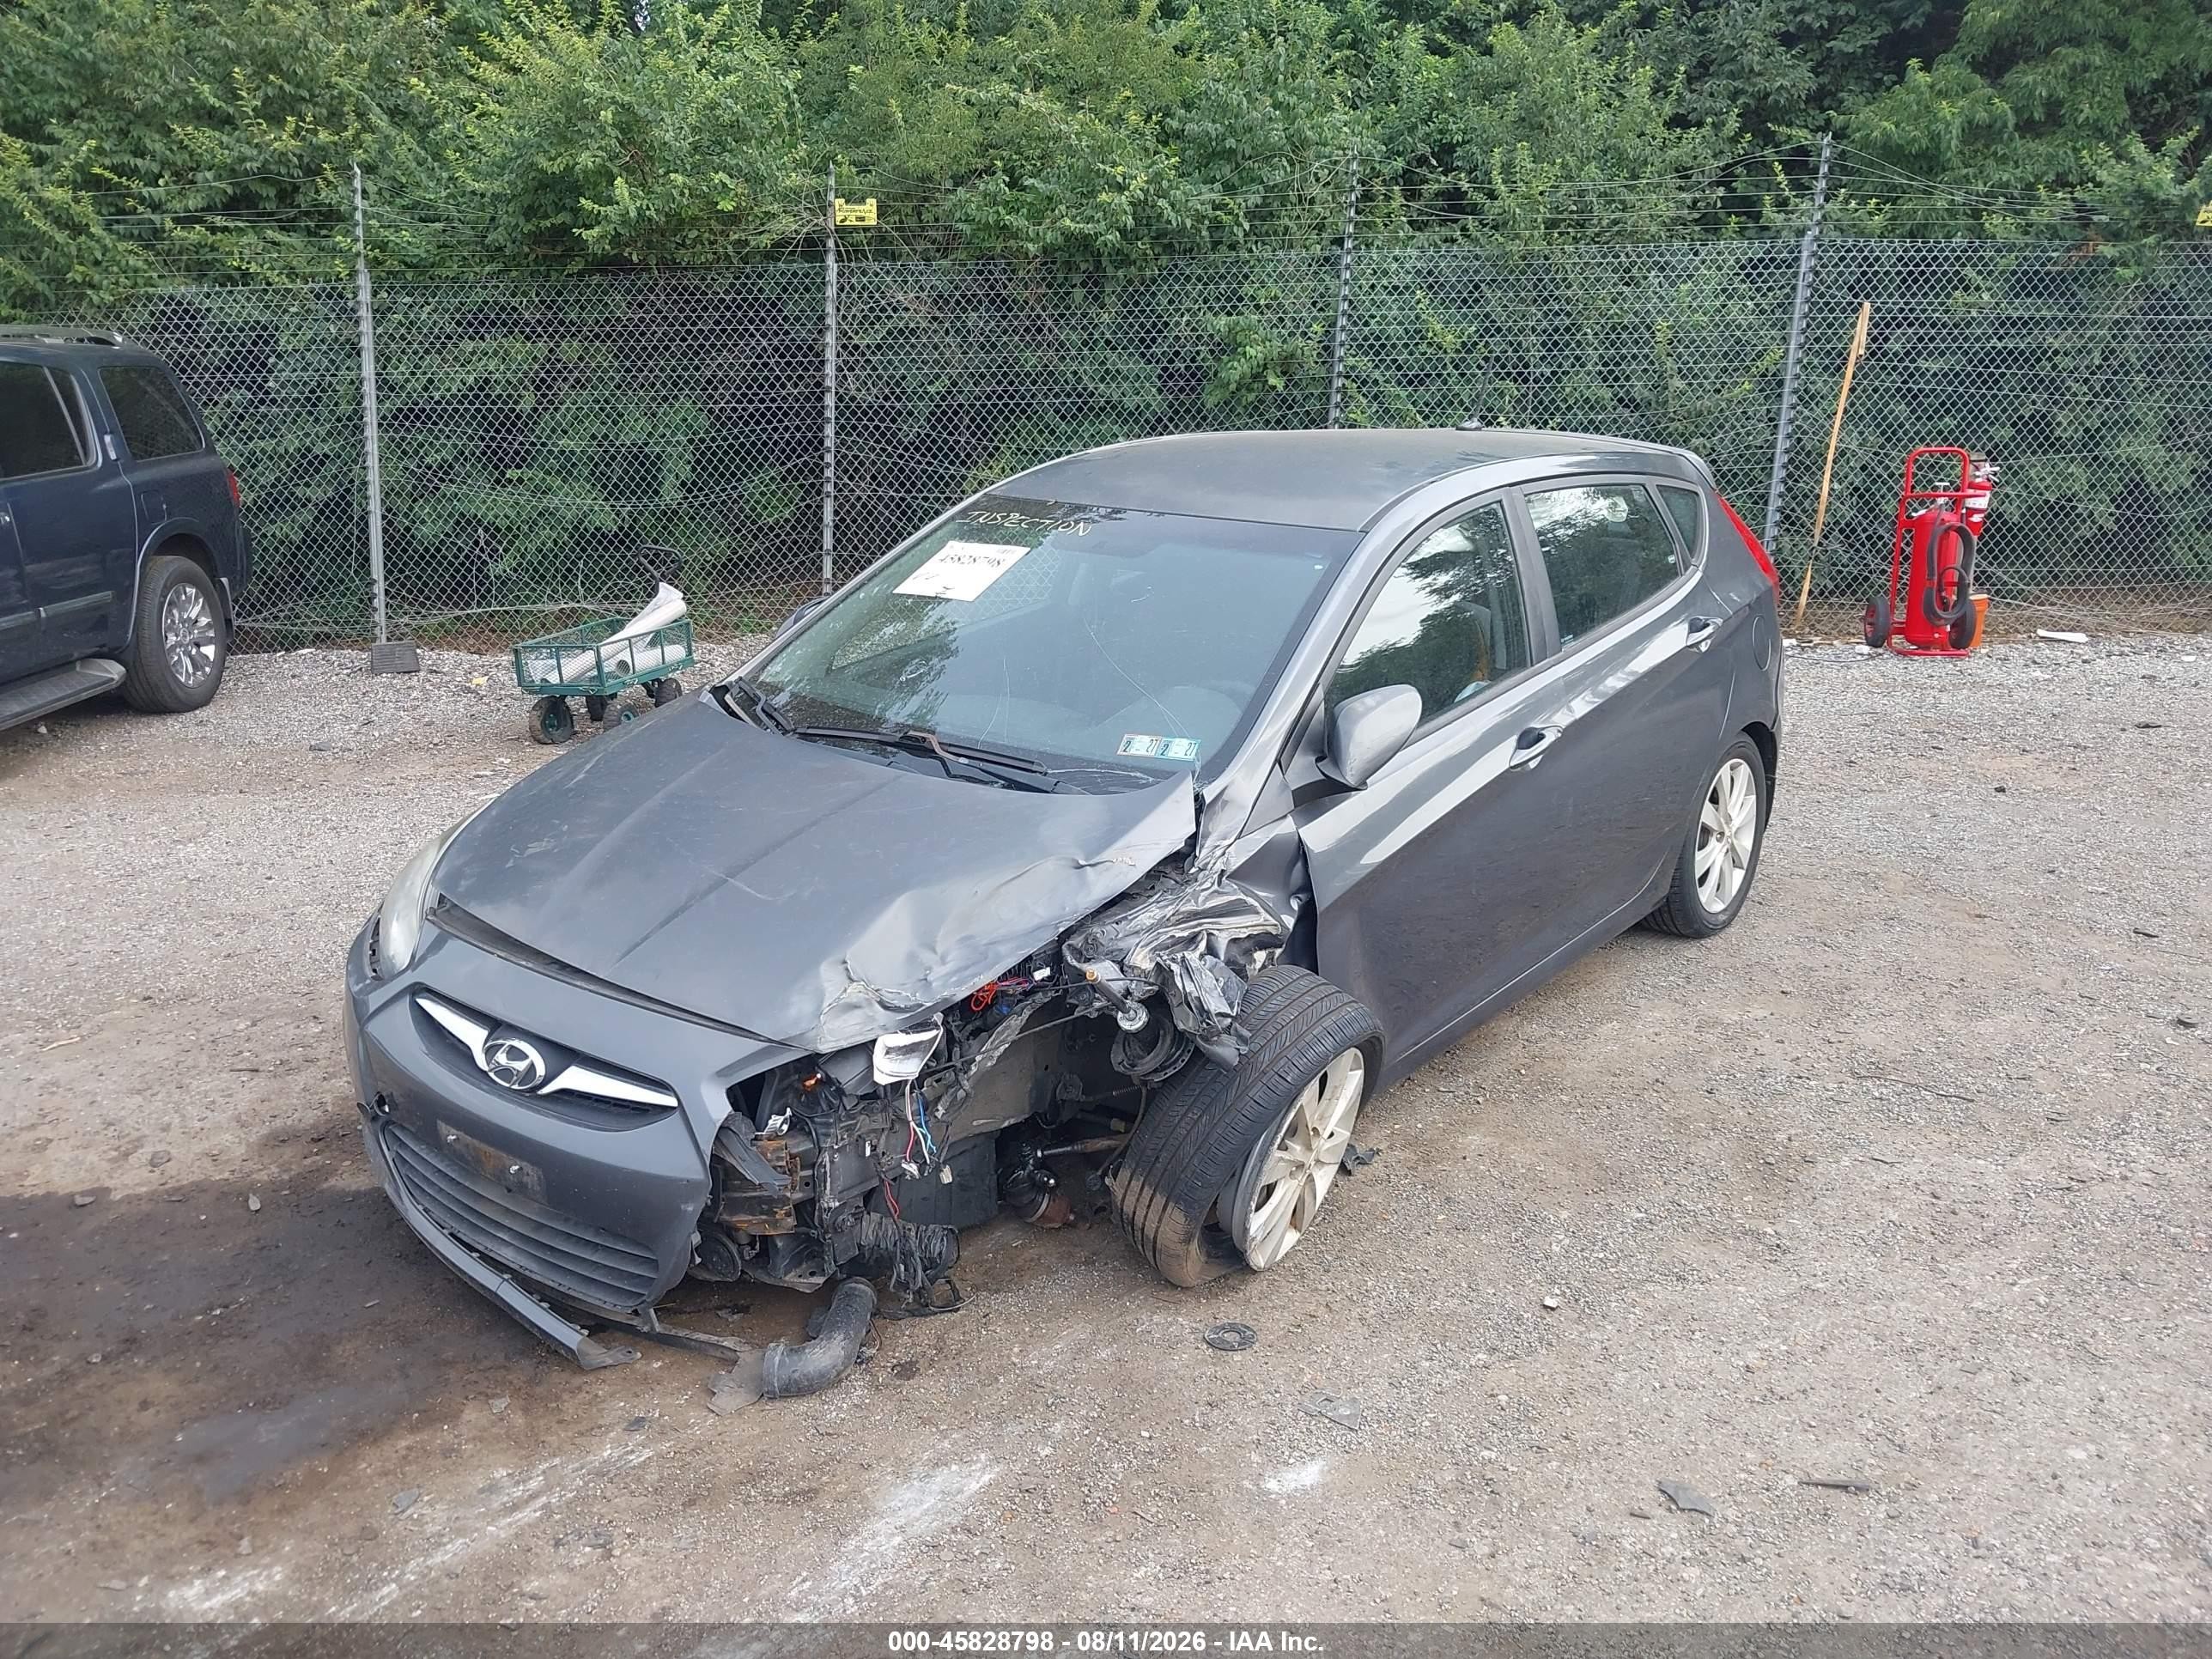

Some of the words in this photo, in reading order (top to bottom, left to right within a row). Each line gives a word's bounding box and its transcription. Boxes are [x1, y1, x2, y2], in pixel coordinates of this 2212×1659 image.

[956, 511, 1092, 537] INSPECTION
[1146, 738, 1158, 754] 27
[1183, 742, 1197, 757] 27
